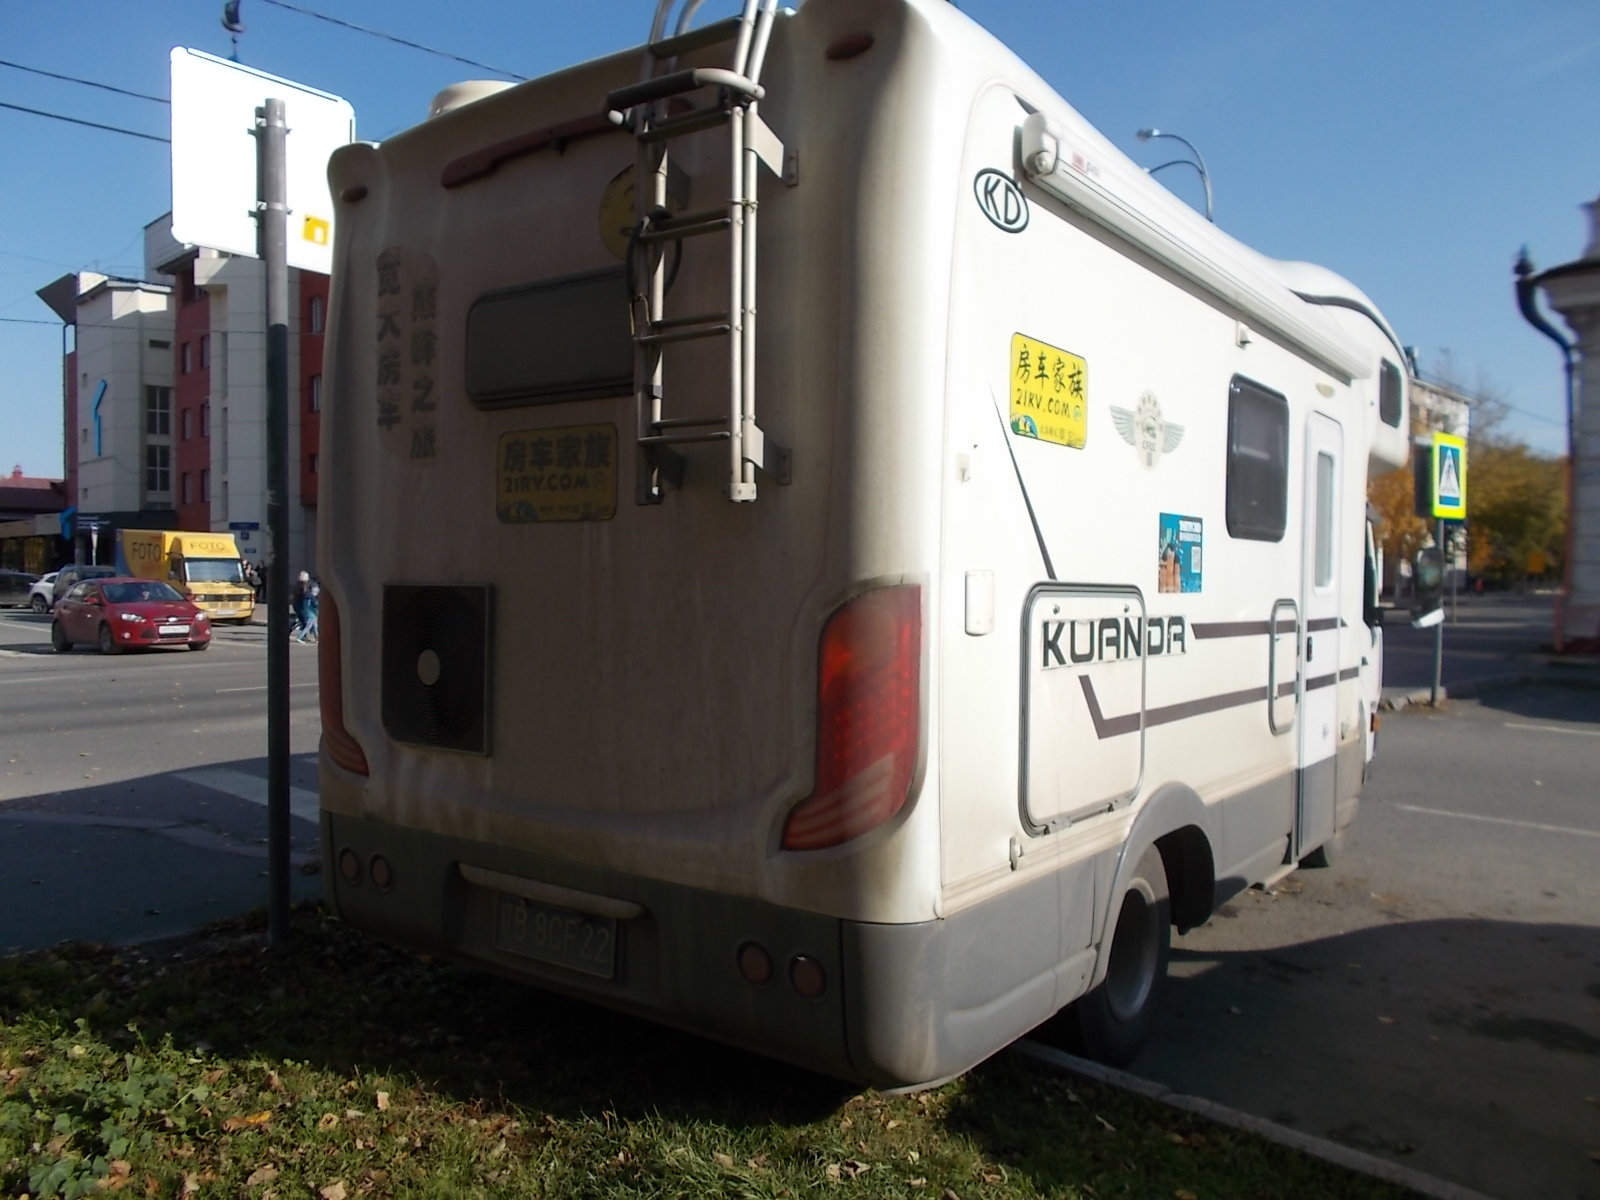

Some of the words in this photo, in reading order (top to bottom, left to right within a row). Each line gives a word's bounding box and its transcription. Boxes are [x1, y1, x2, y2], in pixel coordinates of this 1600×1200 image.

[984, 175, 1021, 225] KD
[1016, 343, 1084, 402] 房车家族
[503, 432, 612, 473] 房车家族
[132, 541, 161, 562] FOTO
[190, 541, 225, 551] FOTO
[1042, 616, 1185, 667] KUANDA
